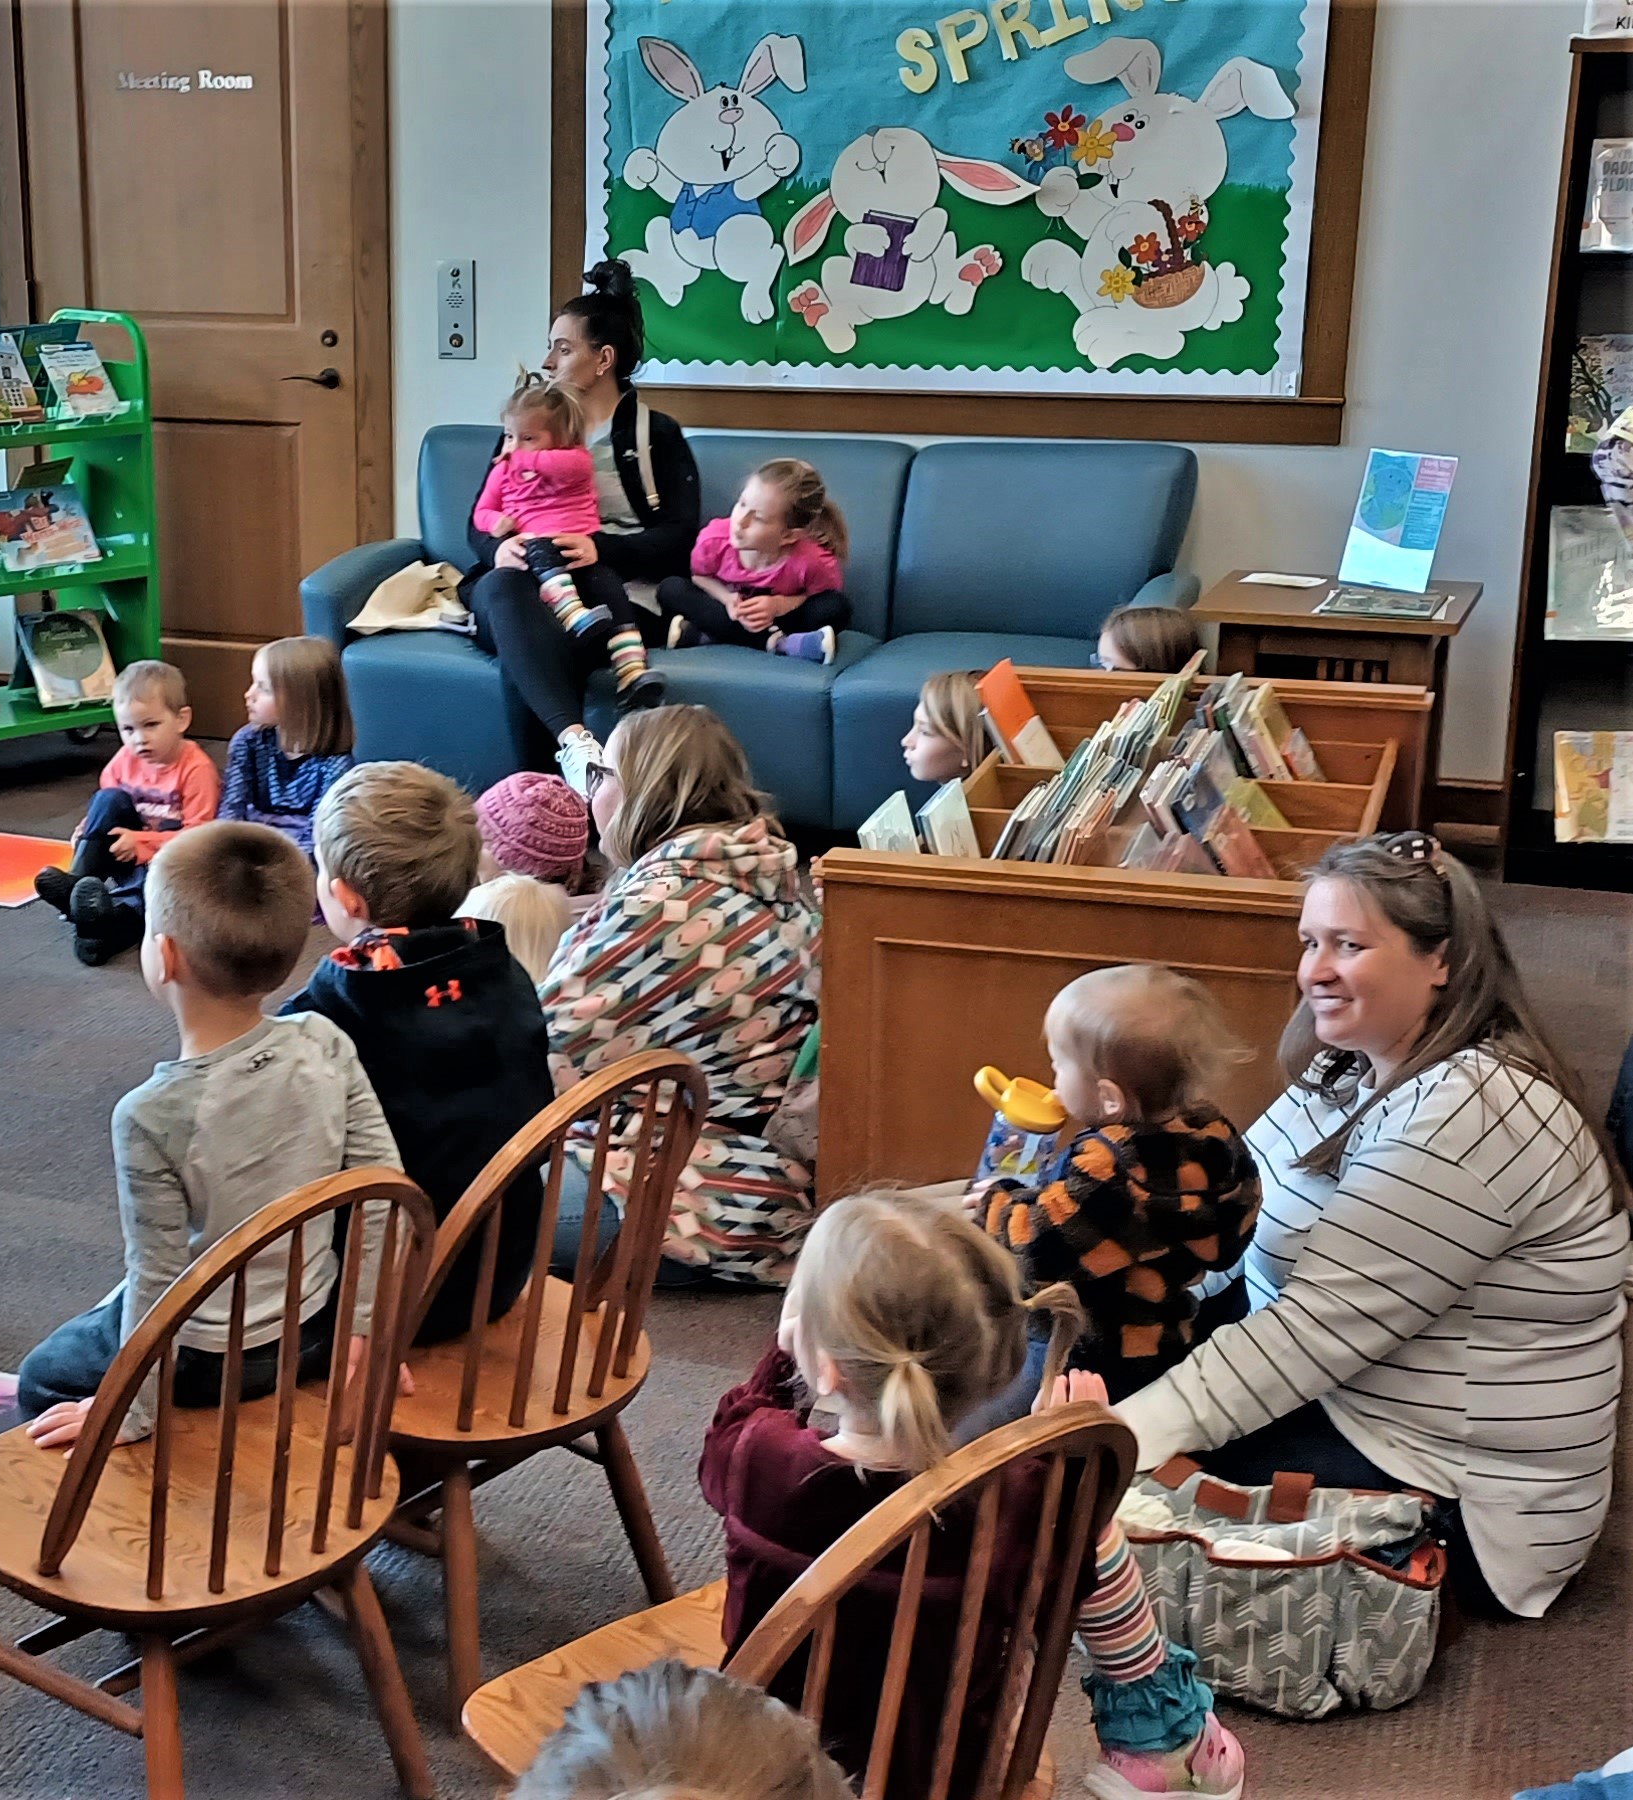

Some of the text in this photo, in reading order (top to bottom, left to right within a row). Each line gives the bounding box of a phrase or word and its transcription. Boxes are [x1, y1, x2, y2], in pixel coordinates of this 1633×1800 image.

[895, 0, 1181, 94] SPRI
[117, 69, 253, 93] Meeting Room
